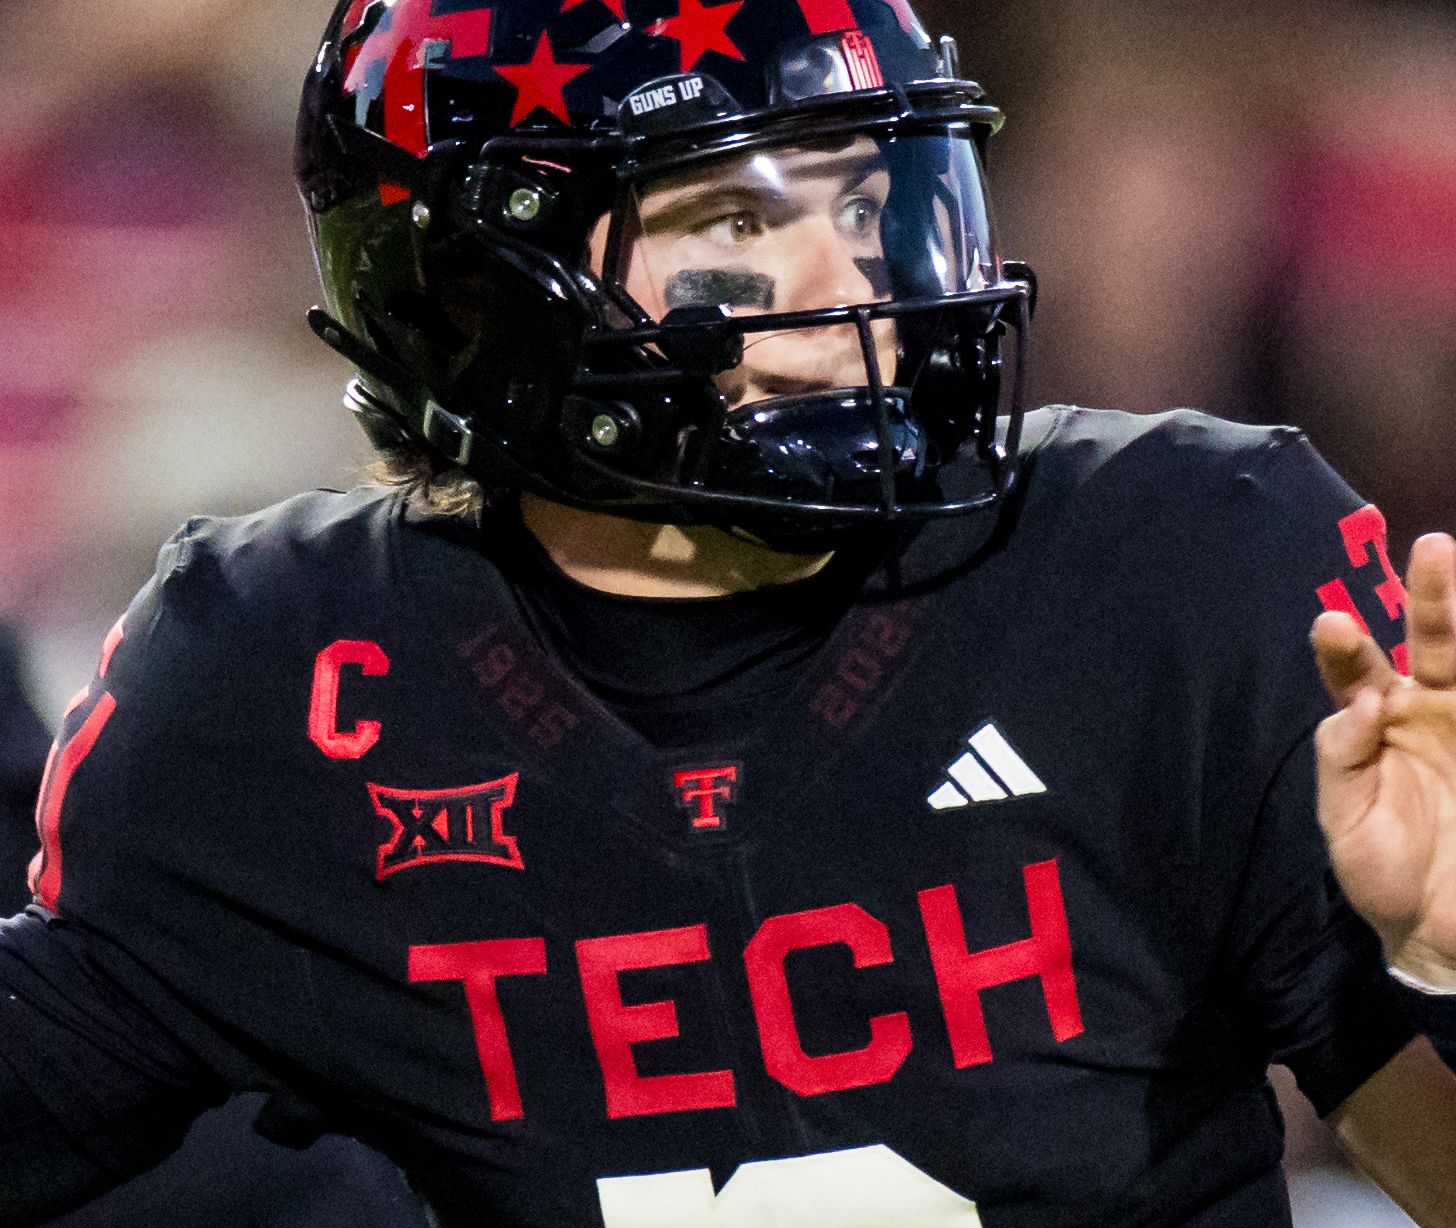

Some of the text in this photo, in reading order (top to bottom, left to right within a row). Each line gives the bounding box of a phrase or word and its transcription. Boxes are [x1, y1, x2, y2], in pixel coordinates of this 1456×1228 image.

[629, 77, 704, 116] GUNS UP
[308, 638, 391, 760] C
[368, 773, 525, 879] XII
[407, 857, 1086, 1122] TECH
